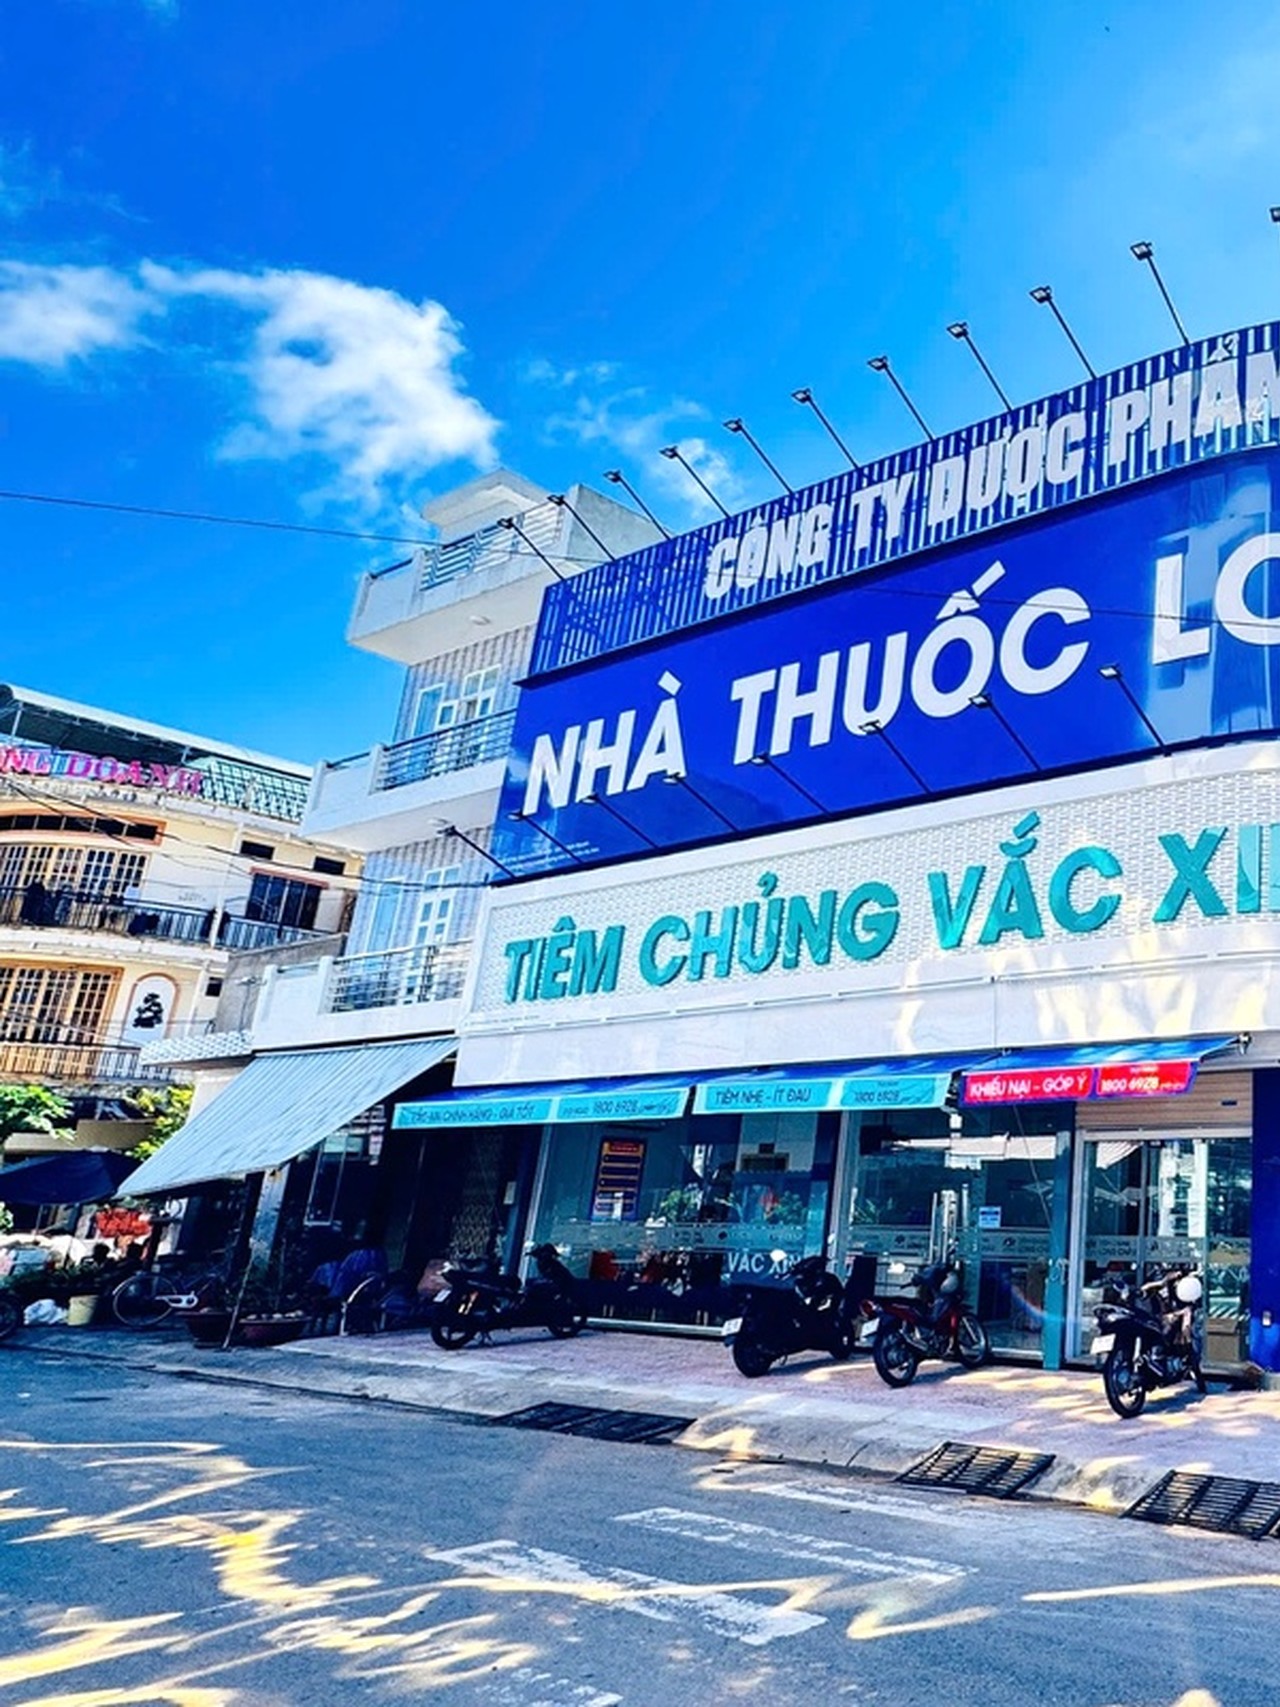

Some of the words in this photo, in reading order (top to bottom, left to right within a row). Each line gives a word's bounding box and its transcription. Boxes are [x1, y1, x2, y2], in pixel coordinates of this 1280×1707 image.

[705, 513, 832, 600] CÔNG
[849, 474, 915, 552] TY
[927, 410, 1088, 527] DƯỢC
[522, 669, 687, 816] NHÀ
[728, 560, 1091, 766] THUỐC
[504, 915, 625, 1003] TIÊM
[638, 870, 900, 986] CHỦNG
[927, 810, 1122, 950] VẮC
[969, 1072, 1006, 1097] KHIẾU
[1042, 1071, 1073, 1093] GÓP
[1077, 1074, 1088, 1091] Ý
[1100, 1078, 1126, 1092] 1800
